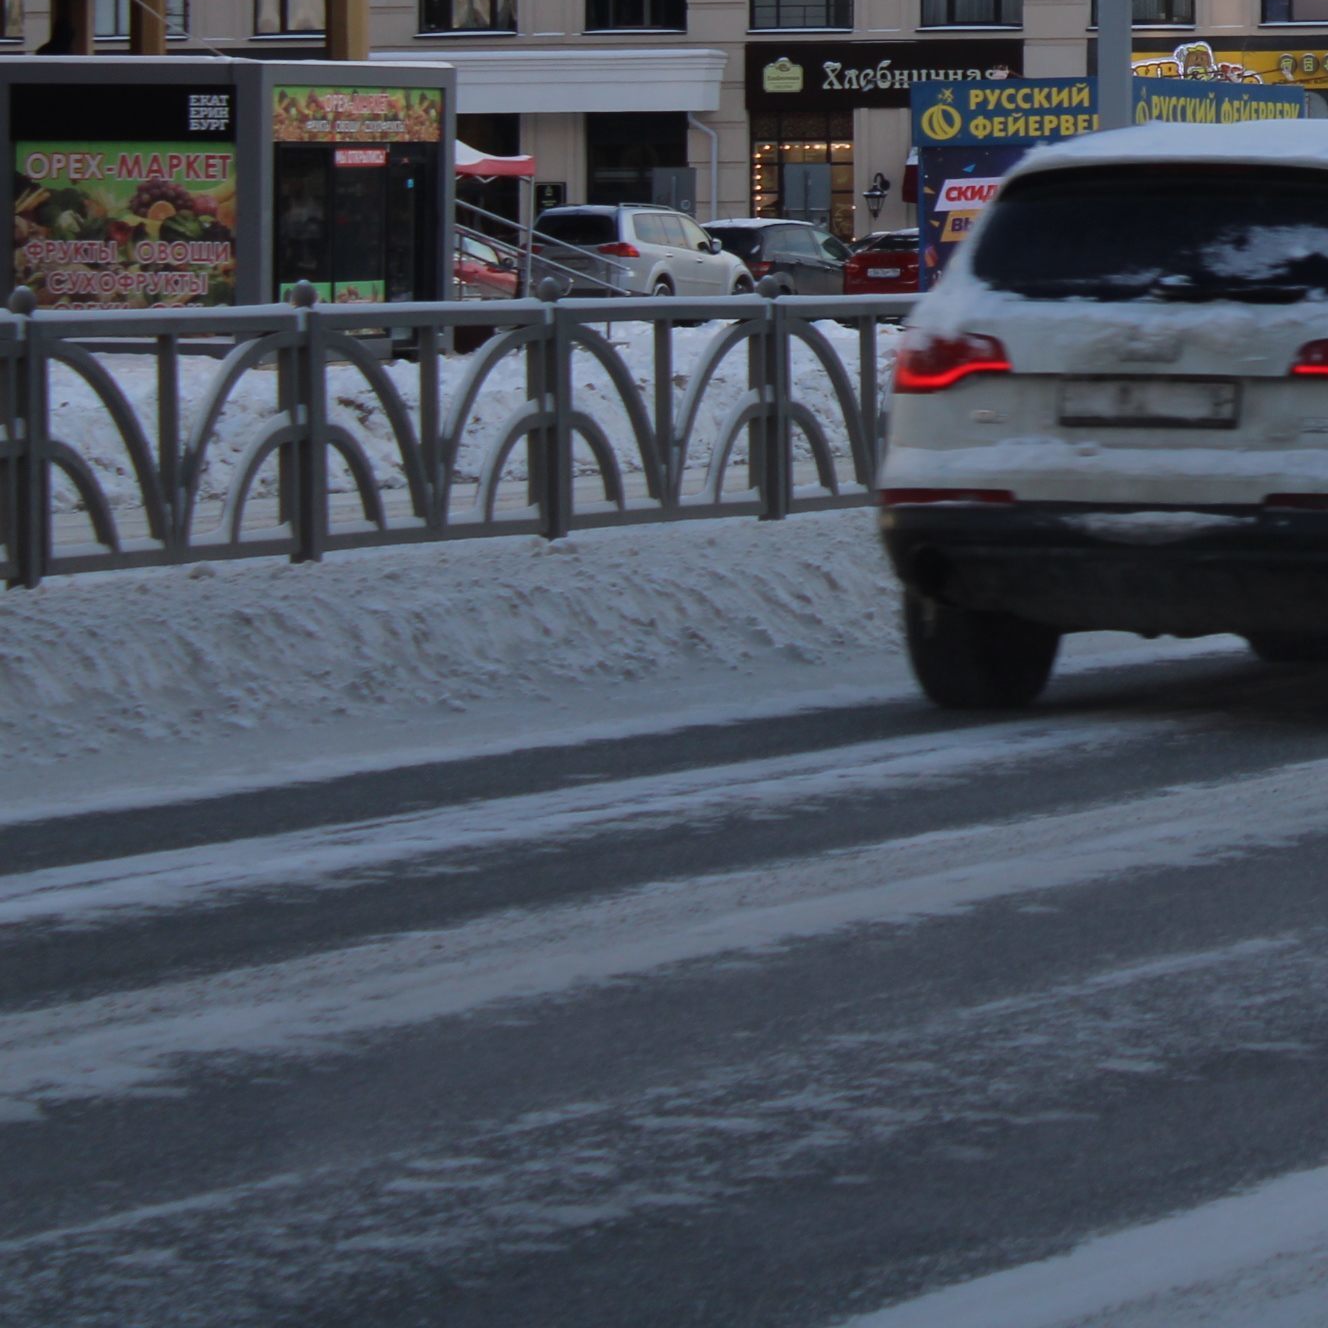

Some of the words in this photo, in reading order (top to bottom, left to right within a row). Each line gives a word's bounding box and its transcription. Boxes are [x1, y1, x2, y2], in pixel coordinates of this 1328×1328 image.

[189, 95, 229, 106] ЕКАТ
[969, 83, 1090, 110] РУССКИЙ
[1152, 92, 1216, 123] РУССКИЙ
[189, 107, 229, 118] ЕРИН
[189, 119, 229, 130] БУРГ
[25, 152, 232, 180] ОРЕХ-МАРКЕТ
[25, 240, 118, 263] ФРУКТЫ
[136, 241, 231, 265] ОВОЩИ
[47, 272, 209, 294] СУХОФРУКТЫ
